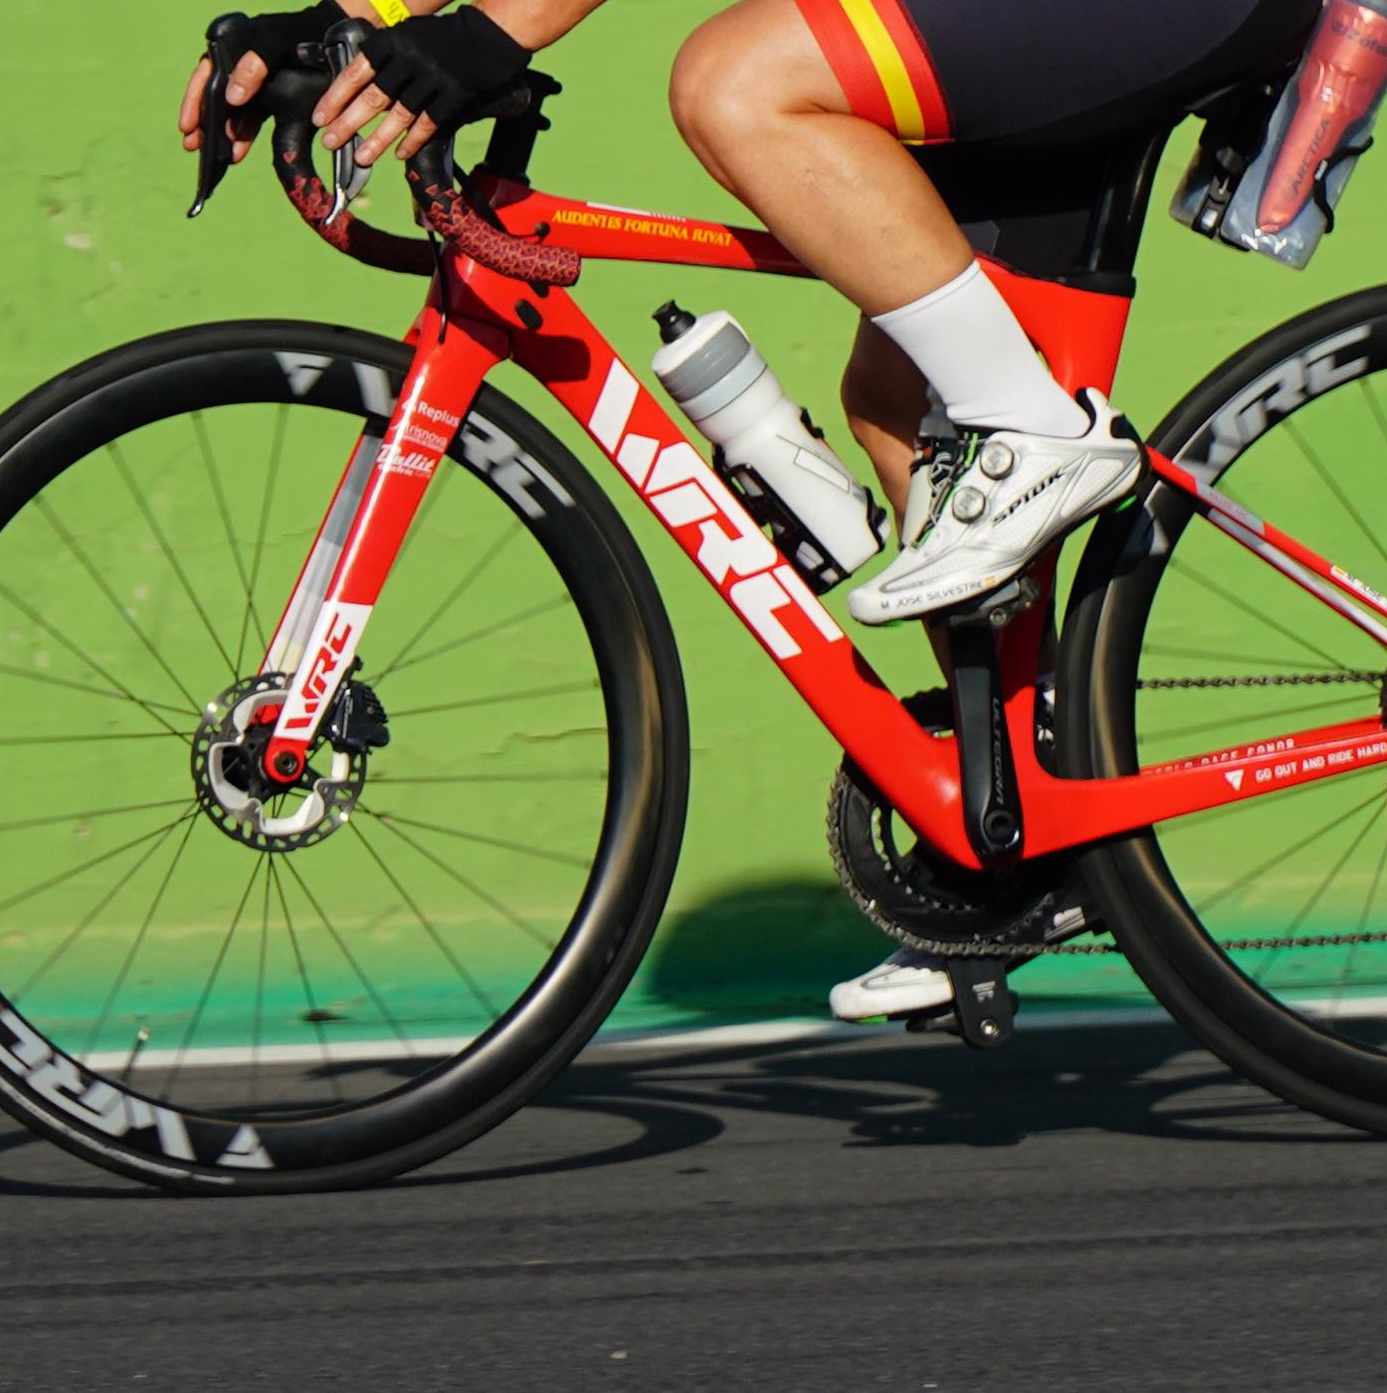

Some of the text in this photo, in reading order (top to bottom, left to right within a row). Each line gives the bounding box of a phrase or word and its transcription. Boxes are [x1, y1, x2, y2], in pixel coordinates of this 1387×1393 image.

[624, 218, 689, 240] FORTUNA
[417, 400, 460, 428] Replus
[588, 356, 846, 660] WRC
[285, 611, 352, 733] WRC
[1255, 767, 1273, 783] GO
[1274, 761, 1298, 779] OUT
[1301, 755, 1326, 772] AND
[1327, 748, 1355, 766] RIDE
